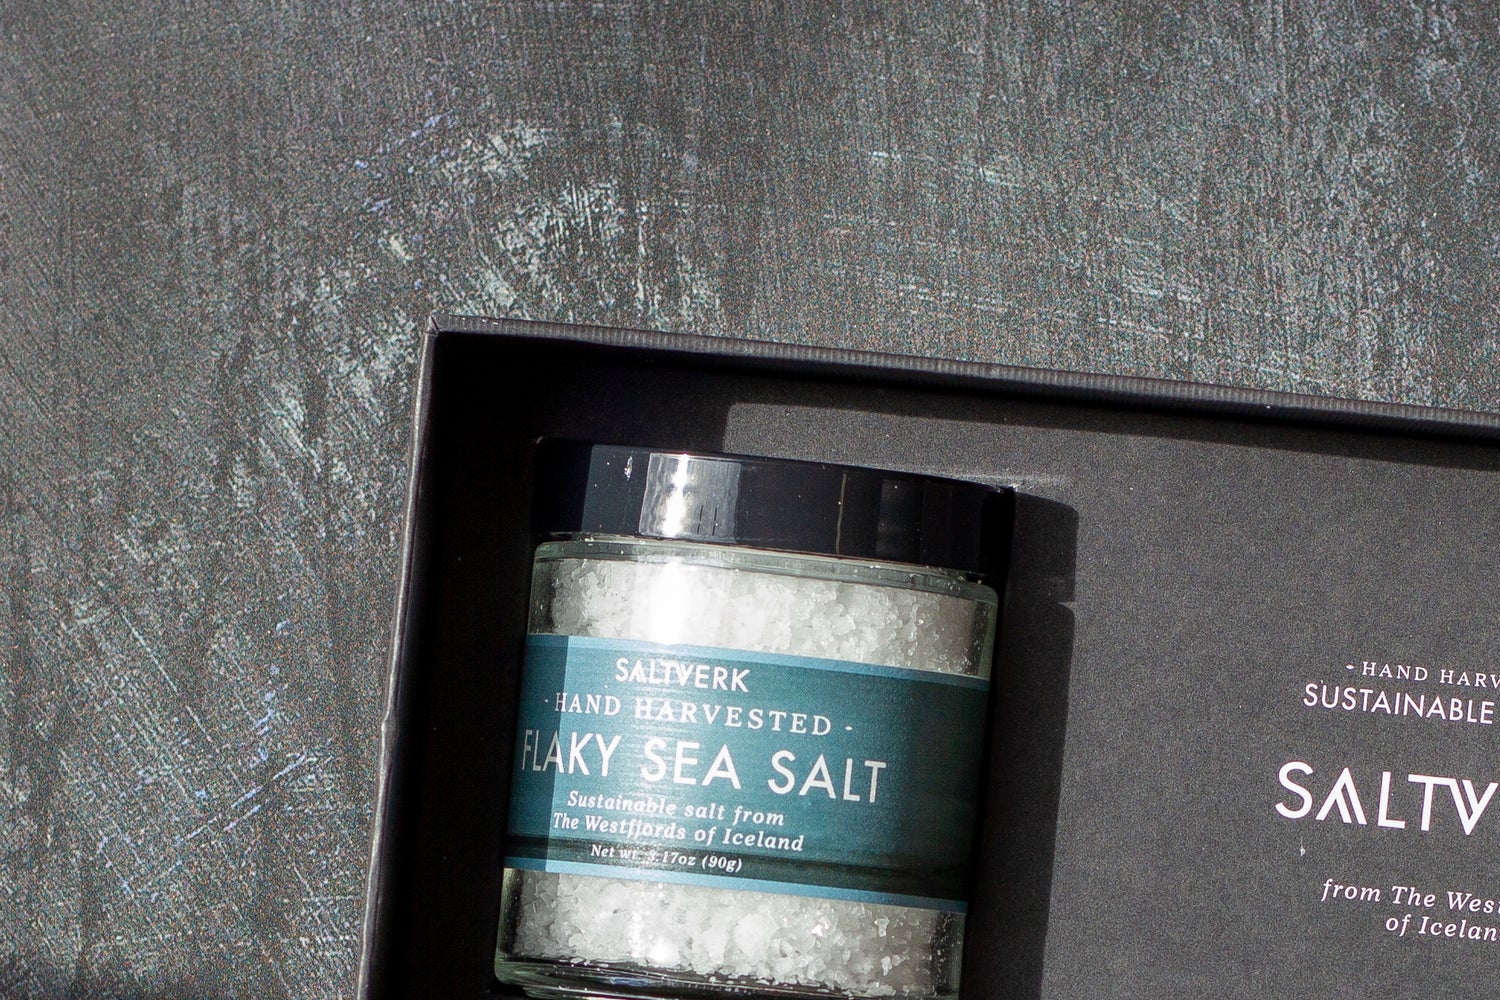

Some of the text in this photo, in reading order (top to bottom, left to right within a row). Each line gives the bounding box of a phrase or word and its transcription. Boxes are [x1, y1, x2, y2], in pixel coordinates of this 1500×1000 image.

[615, 658, 749, 692] SALTVERK
[1362, 662, 1428, 681] HAND
[555, 692, 831, 735] HAND HARVESTED
[1303, 683, 1494, 724] SUSTAINABLE
[522, 729, 886, 803] FLAKY SEA SALT
[567, 790, 785, 826] Sustainable salt from
[554, 812, 804, 852] The Westfjords of Iceland
[591, 845, 742, 872] Net wt. 3.17oz (90g)
[1321, 879, 1381, 902] from
[1392, 886, 1435, 907] The
[1386, 914, 1411, 936] of
